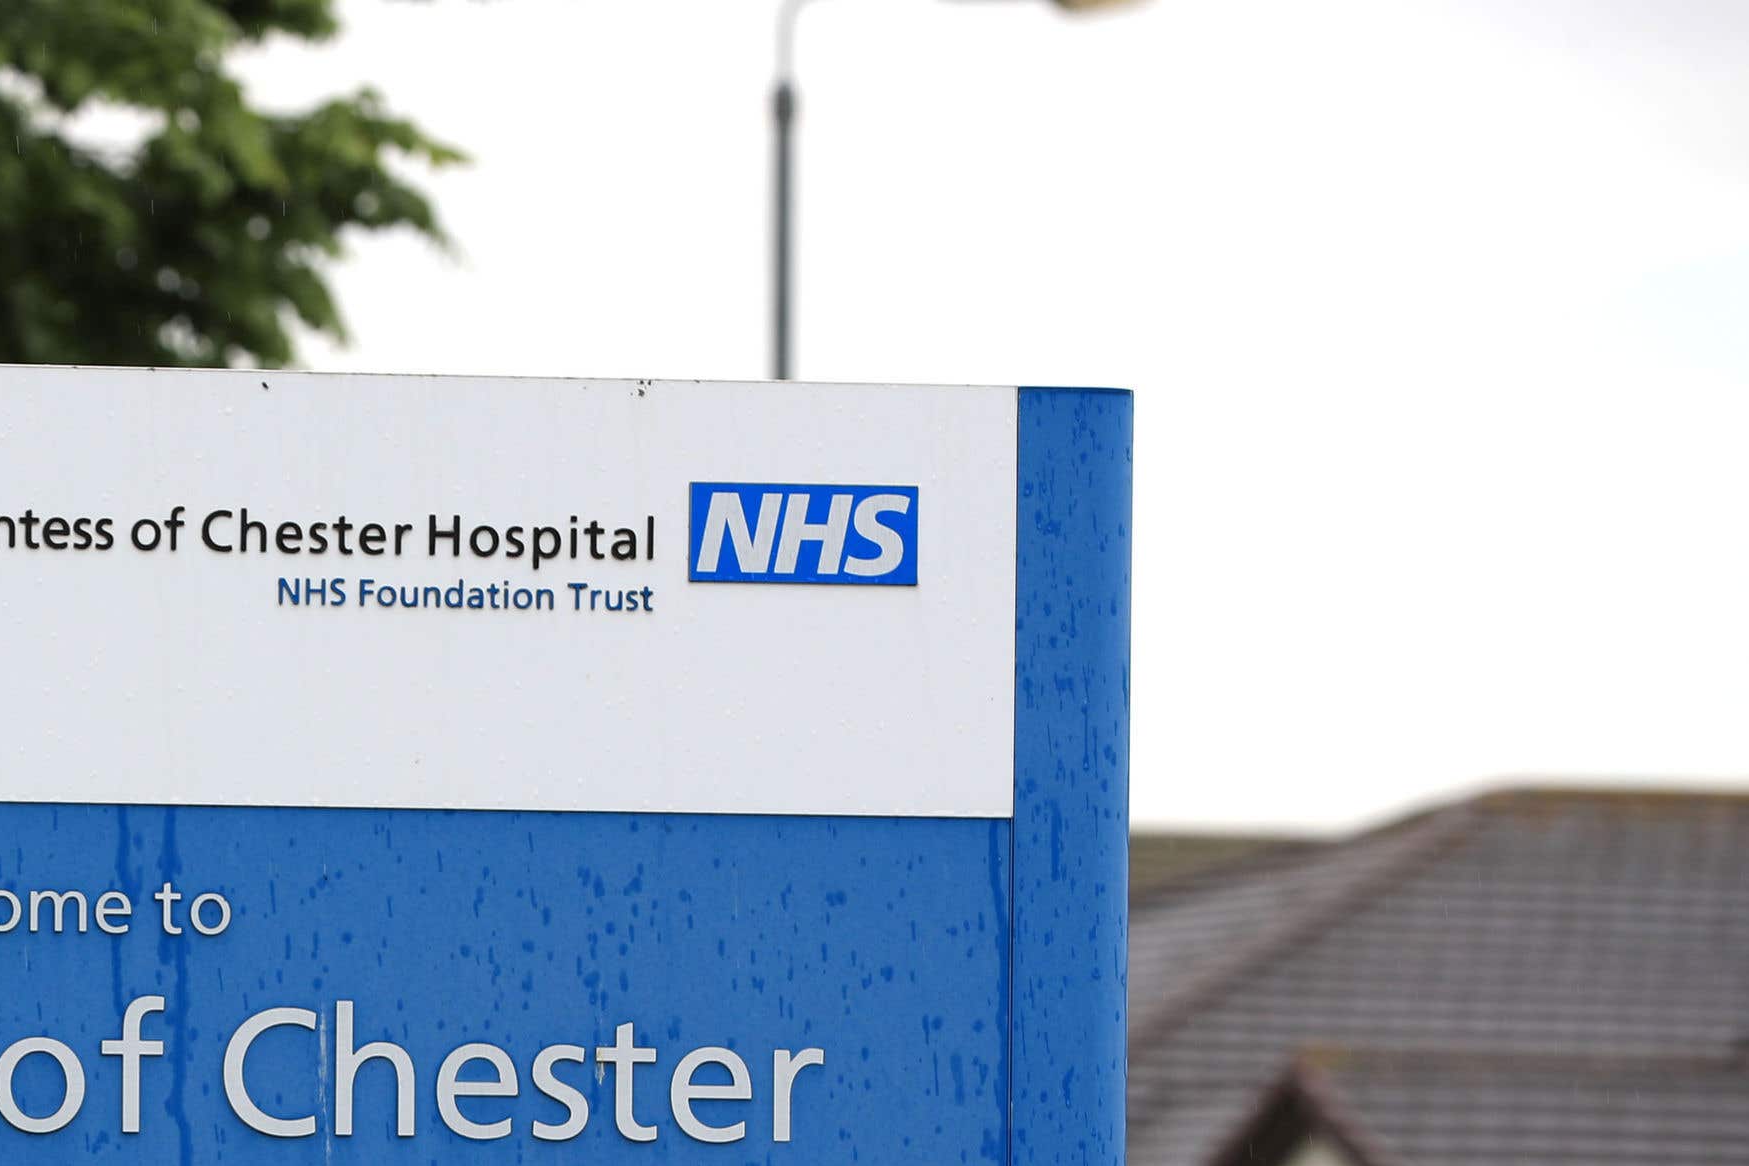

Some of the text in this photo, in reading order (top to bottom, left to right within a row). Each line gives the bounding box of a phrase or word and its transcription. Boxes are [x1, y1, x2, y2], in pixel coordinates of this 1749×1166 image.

[130, 506, 186, 552] of
[201, 507, 413, 556] Chester
[428, 514, 655, 571] Hospital
[701, 492, 910, 576] NHS
[277, 577, 654, 613] NHS Foundation Trust
[154, 882, 231, 935] to
[223, 1000, 824, 1143] Chester
